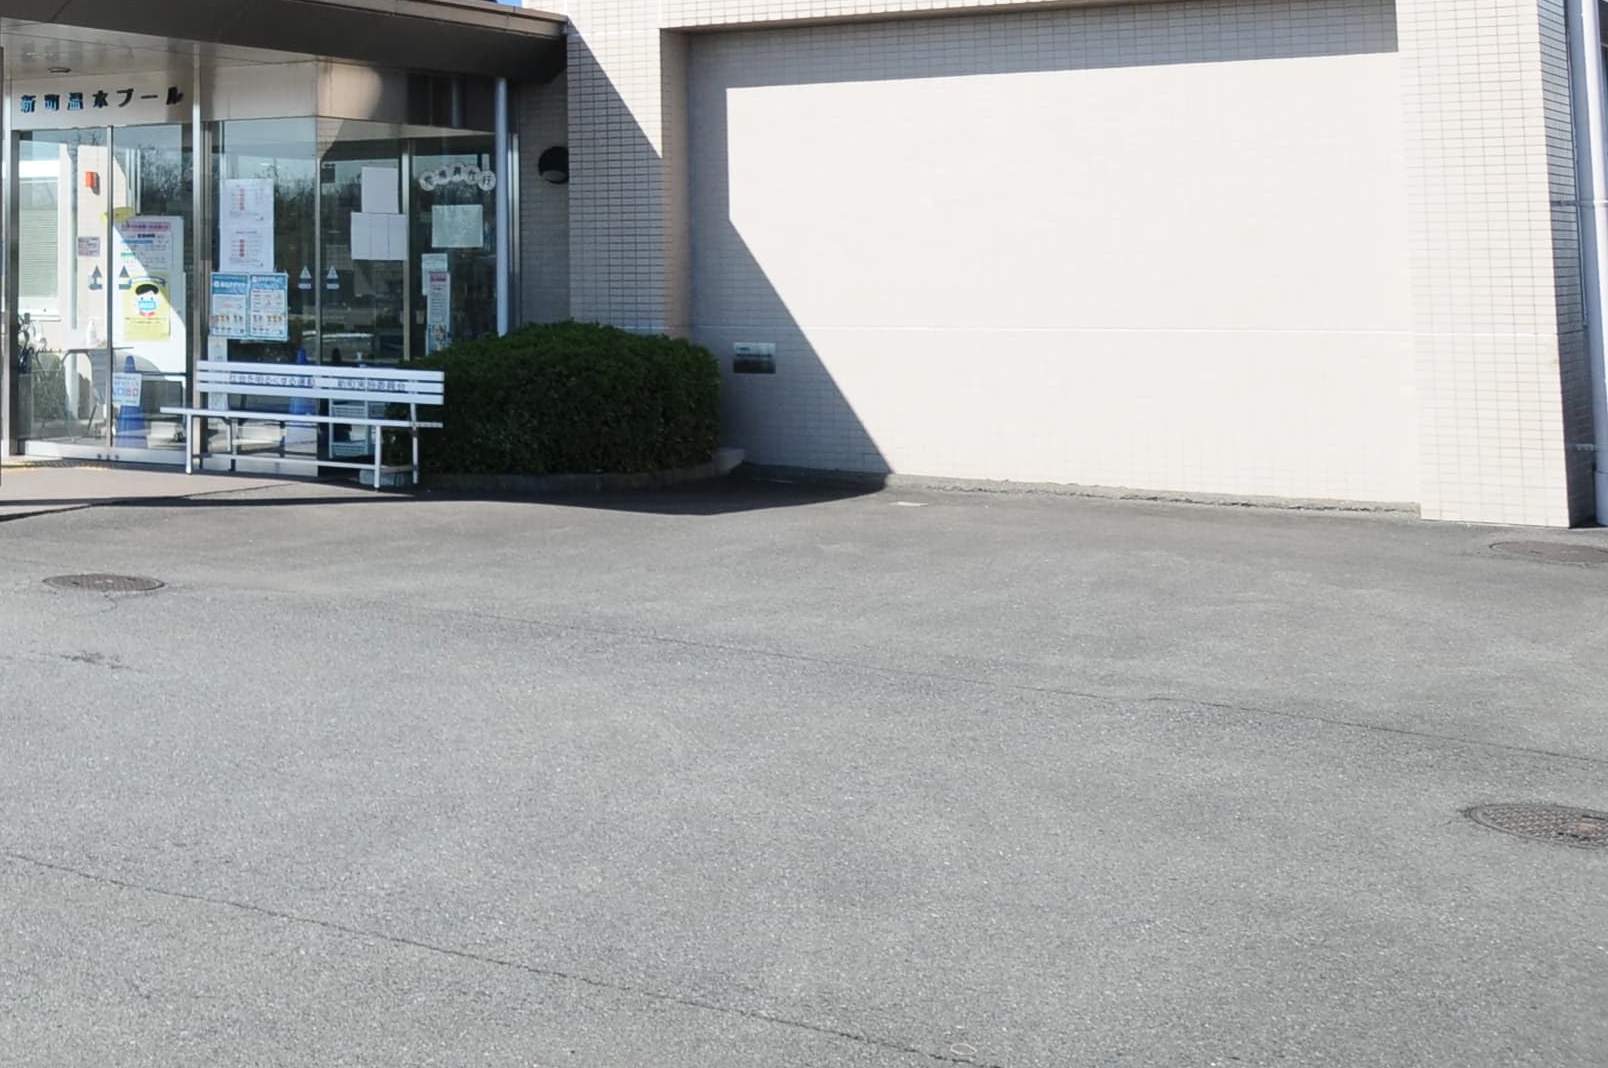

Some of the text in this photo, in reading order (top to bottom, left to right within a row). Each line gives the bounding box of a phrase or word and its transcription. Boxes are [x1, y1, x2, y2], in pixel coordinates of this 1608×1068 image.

[20, 86, 184, 113] 新町温水プール
